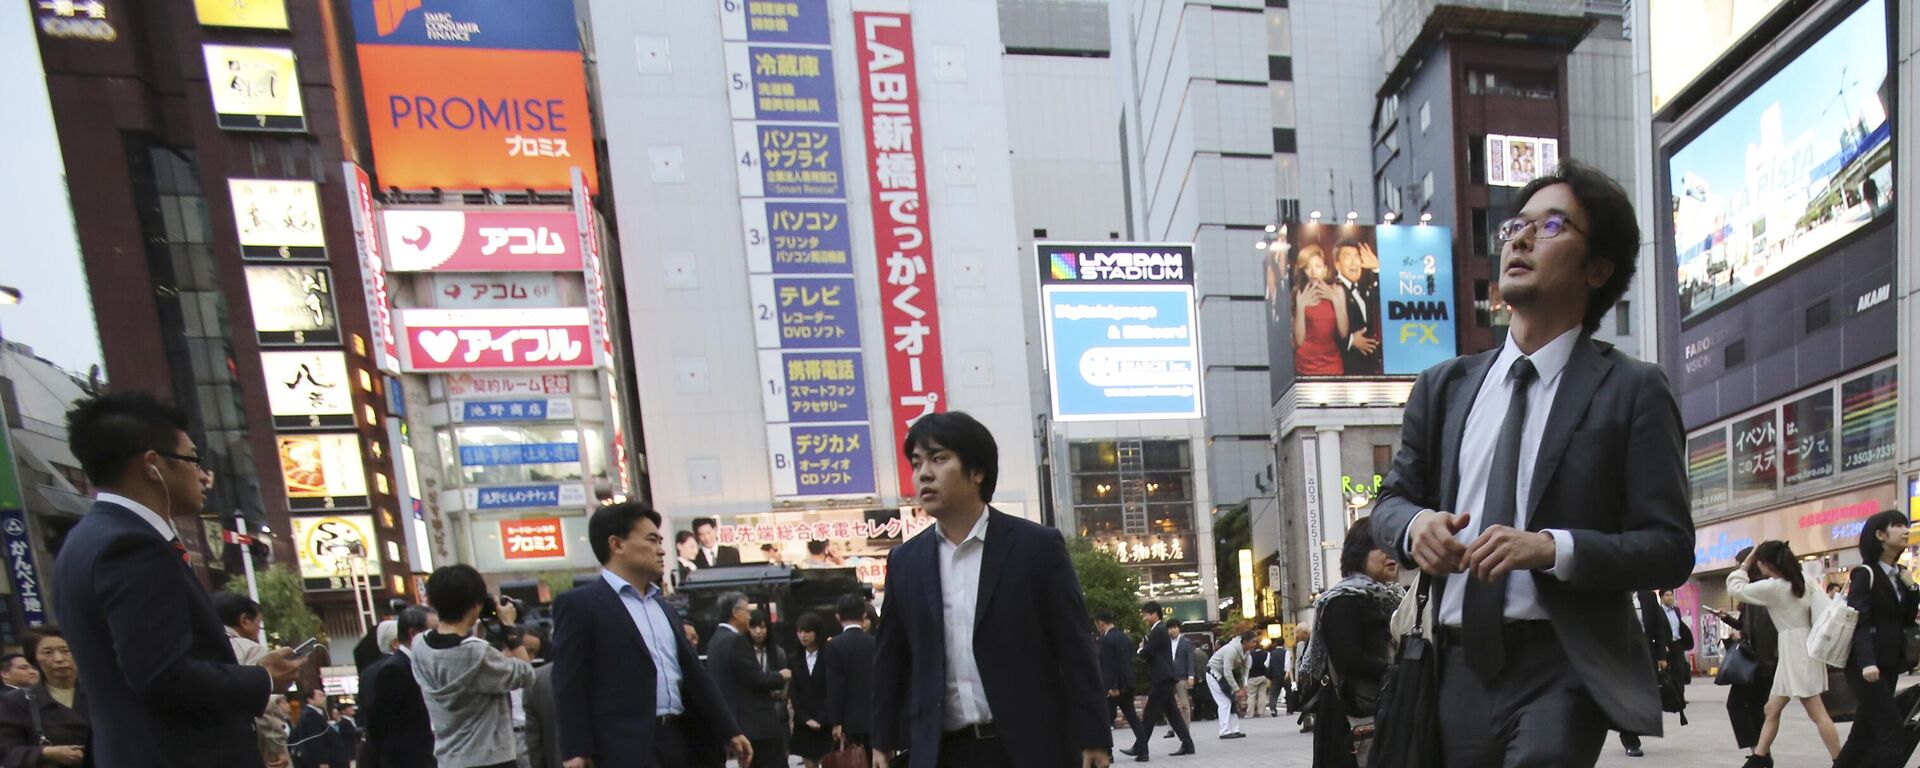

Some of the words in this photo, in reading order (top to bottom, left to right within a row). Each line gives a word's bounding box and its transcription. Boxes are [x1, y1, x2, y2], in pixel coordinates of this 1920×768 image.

[424, 12, 452, 23] SMBC
[425, 21, 481, 34] CONSUMER
[427, 30, 471, 42] FINANCE
[755, 53, 821, 77] 冷蔵庫
[389, 95, 567, 132] PROMISE
[505, 135, 570, 157] プロミス
[763, 130, 829, 149] パソコン
[763, 149, 829, 168] サプライ
[772, 210, 839, 231] パソコン
[478, 227, 566, 256] アコム
[774, 236, 819, 249] プリンタ
[1078, 252, 1183, 267] LIVEDAM
[1079, 266, 1184, 281] STADIUM
[471, 284, 527, 299] アコム
[533, 286, 550, 298] 6F
[779, 286, 841, 306] テレビ
[1856, 284, 1891, 312] AKAMI
[782, 312, 835, 324] レコーダー
[1388, 300, 1449, 321] DMM
[783, 326, 811, 338] DVD
[814, 326, 845, 338] ソフト
[1400, 322, 1440, 344] FX
[458, 329, 582, 364] アイフル
[1685, 336, 1711, 359] FARO
[788, 359, 855, 382] 携帯電話
[473, 376, 541, 393] 契約ルーム
[790, 385, 855, 398] スマートフォン
[470, 401, 543, 418] 池野商店
[792, 401, 848, 413] アクセサリー
[796, 434, 861, 455] デジカメ
[799, 459, 851, 471] オーディオ
[801, 473, 819, 485] CD
[821, 473, 852, 485] ソフト
[1310, 509, 1319, 547] 5251
[507, 534, 559, 552] プロミス
[9, 540, 42, 612] かんべ土地
